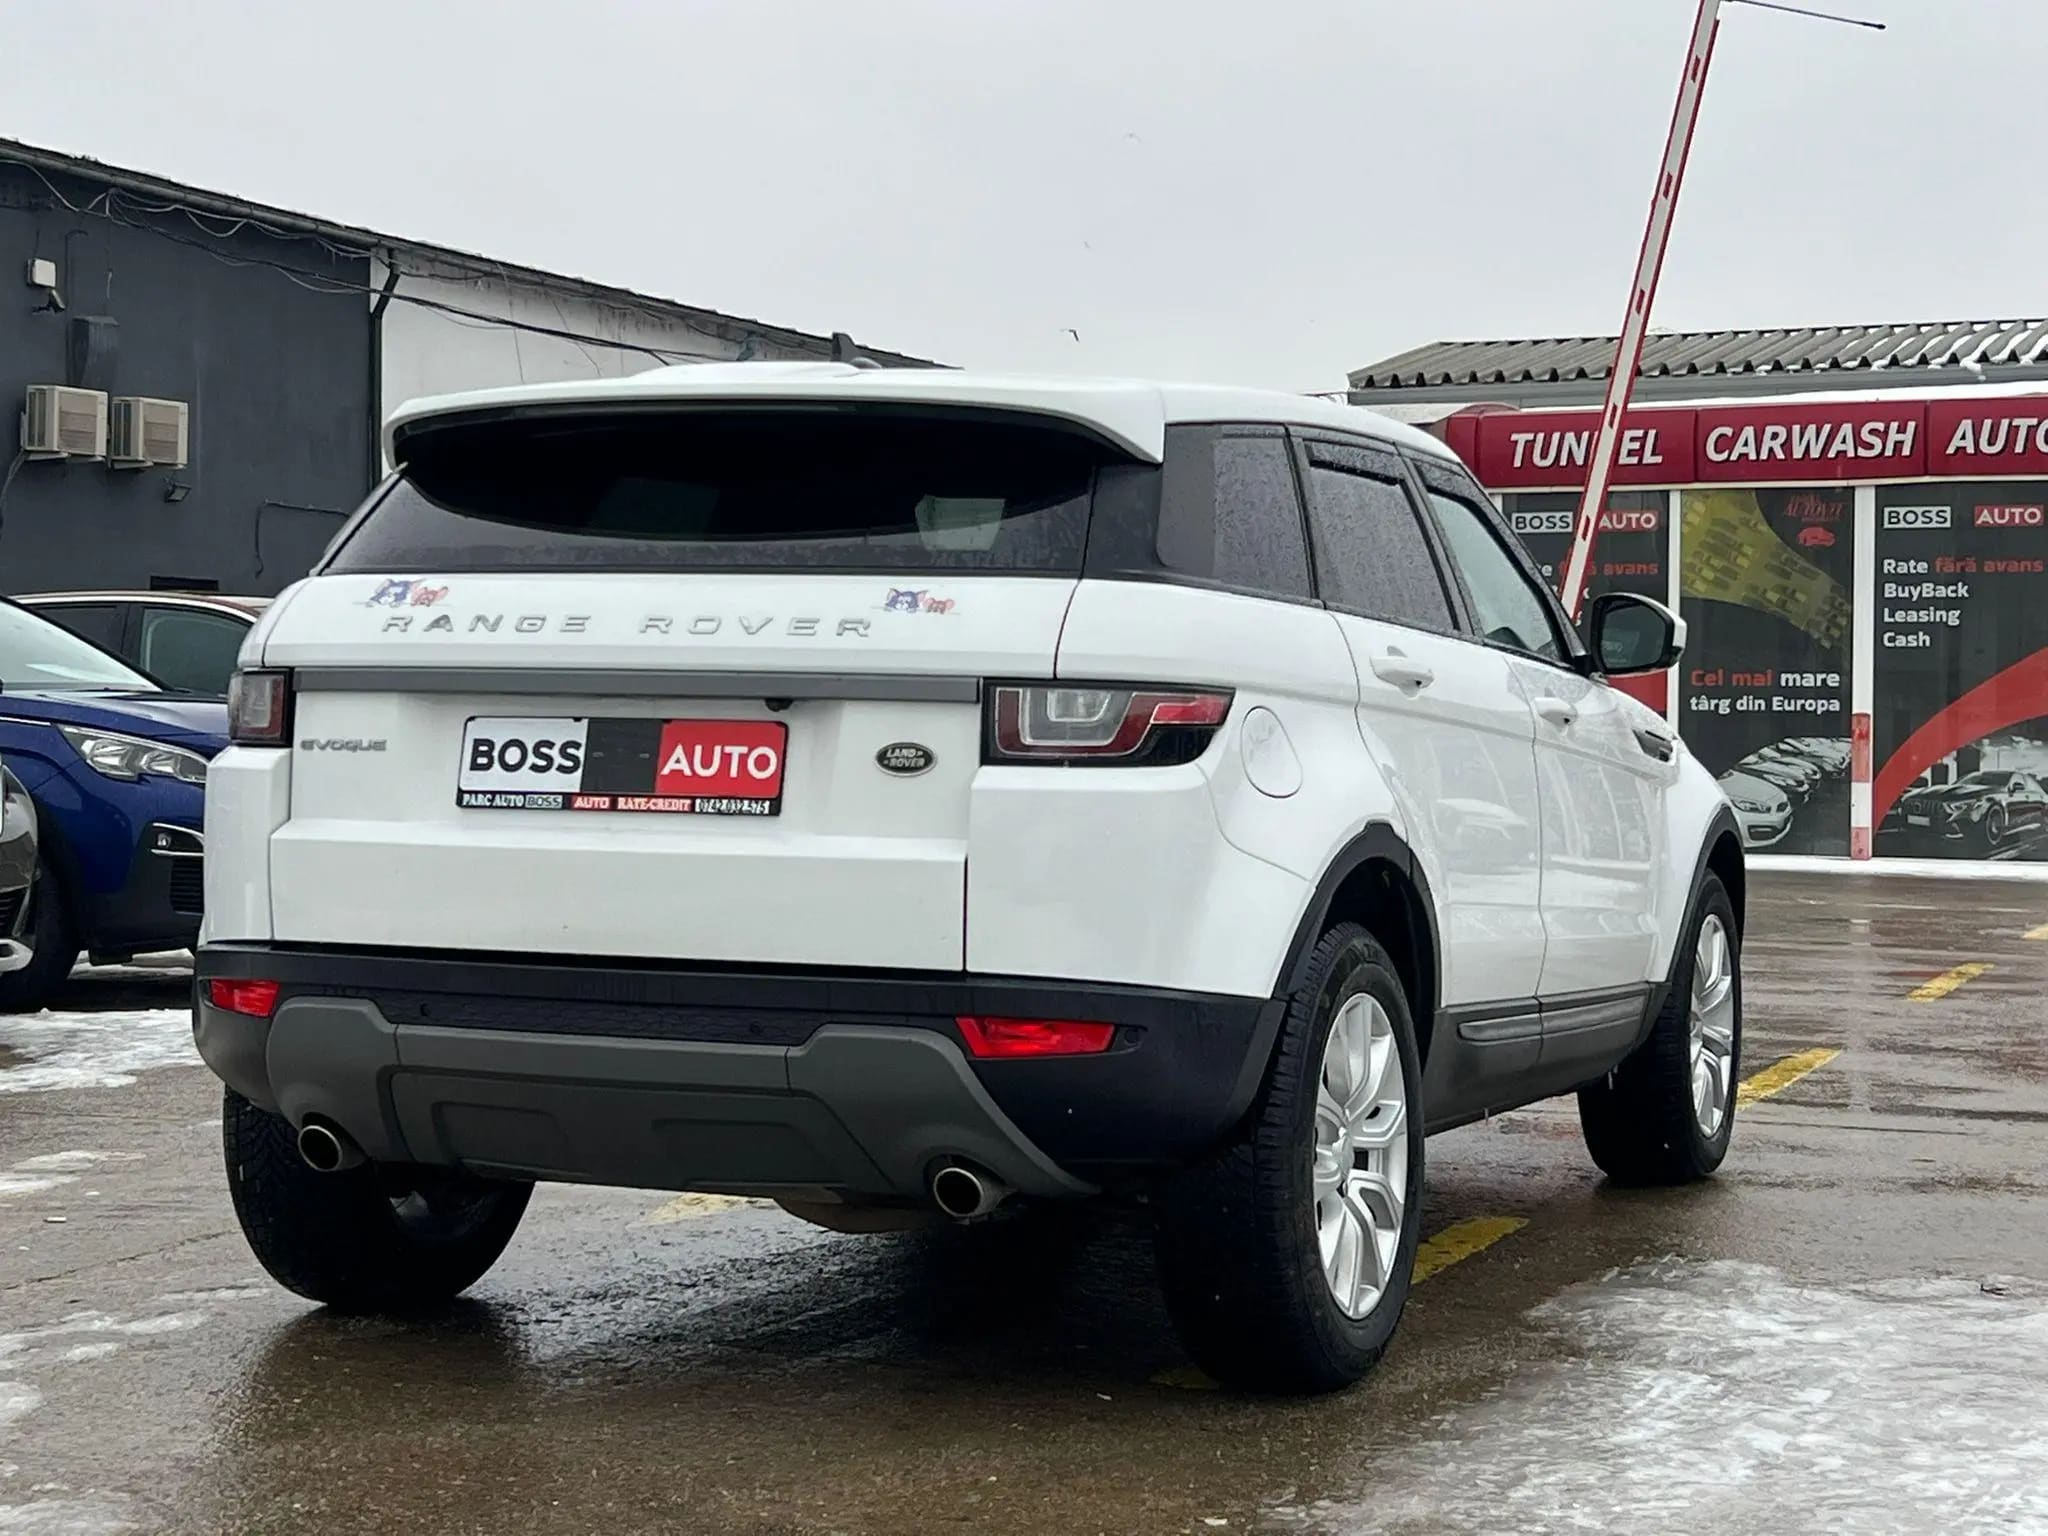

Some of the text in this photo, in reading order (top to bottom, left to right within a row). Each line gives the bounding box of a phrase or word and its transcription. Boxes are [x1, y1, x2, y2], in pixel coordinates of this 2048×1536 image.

[1510, 429, 1663, 468] TUNEL
[1705, 421, 1916, 461] CARWASH
[1515, 513, 1656, 530] BOSS AUTO
[1887, 508, 2042, 525] BOSS AUTO
[1603, 562, 1658, 576] avans
[1883, 558, 1928, 574] Rate
[1983, 559, 2044, 573] avans
[1884, 582, 1969, 601] BuyBack
[1883, 606, 1961, 626] Leasing
[381, 613, 871, 638] RANGE ROVER
[1883, 631, 1930, 647] Cash
[1691, 668, 1840, 687] Cel mai mare
[1690, 695, 1840, 714] târg din Europa
[300, 739, 387, 753] EVOQUE
[886, 748, 917, 758] LAND
[469, 738, 778, 779] BOSS AUTO
[889, 758, 925, 767] ROVER
[463, 794, 492, 806] PARC
[493, 795, 524, 807] AUTO
[527, 796, 562, 807] BOSS
[574, 797, 610, 809] AUTO
